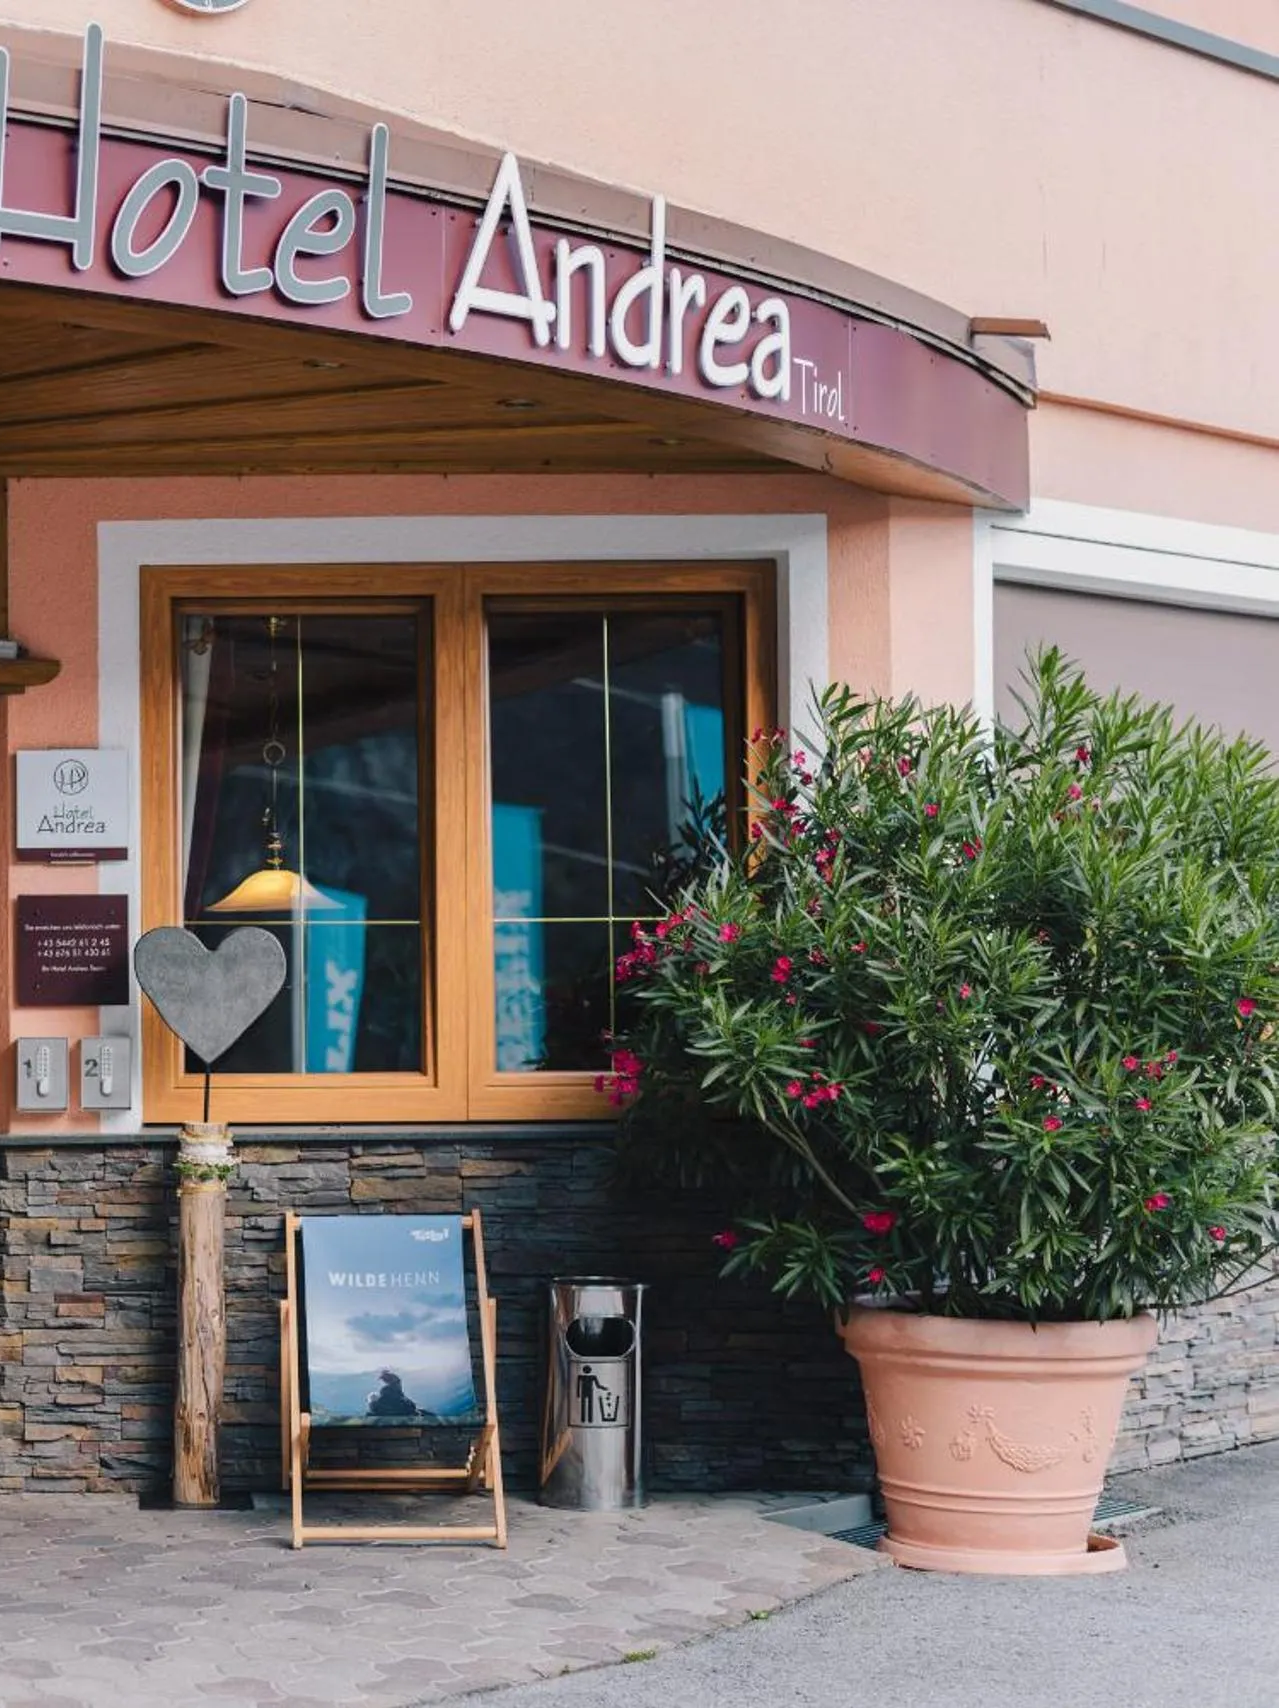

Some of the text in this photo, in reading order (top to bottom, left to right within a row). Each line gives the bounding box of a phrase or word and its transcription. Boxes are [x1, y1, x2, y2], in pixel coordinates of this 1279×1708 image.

[448, 151, 792, 400] Andrea
[793, 357, 846, 422] Tirol
[53, 801, 94, 819] Hotel
[37, 815, 106, 834] Andrea
[23, 1059, 33, 1078] 1
[84, 1058, 99, 1078] 2
